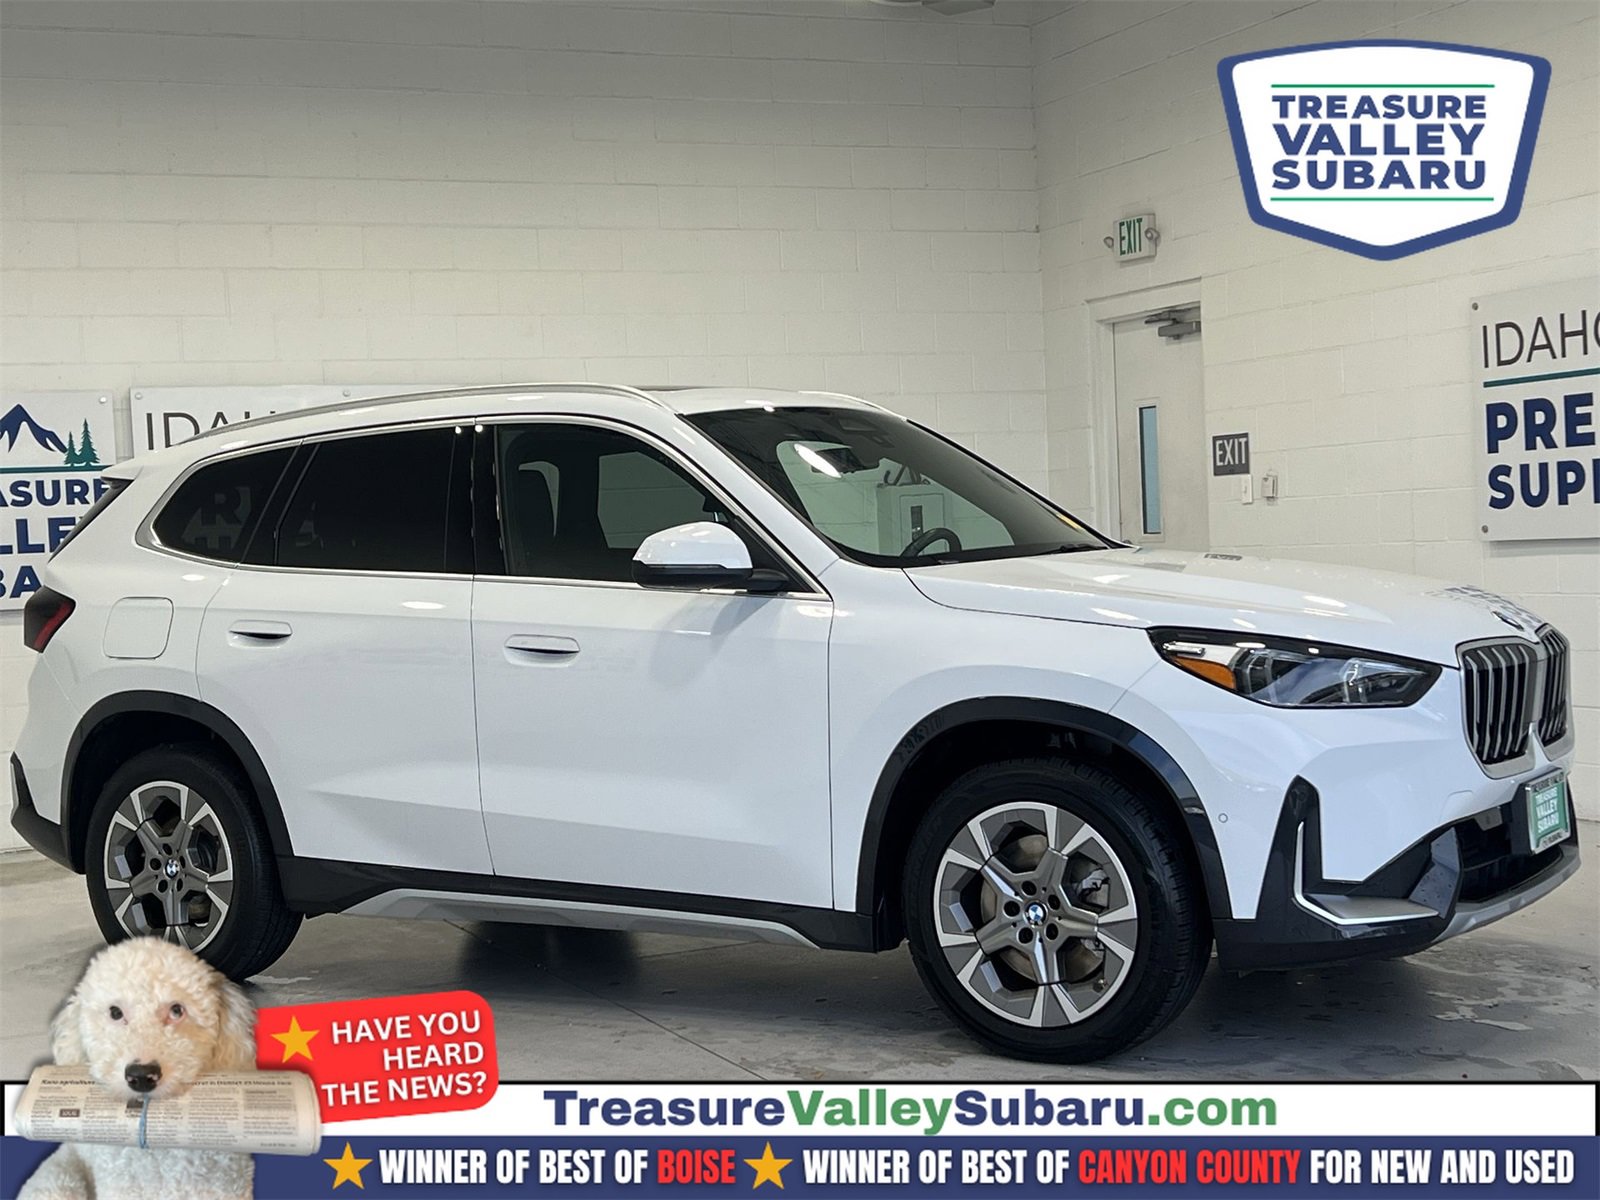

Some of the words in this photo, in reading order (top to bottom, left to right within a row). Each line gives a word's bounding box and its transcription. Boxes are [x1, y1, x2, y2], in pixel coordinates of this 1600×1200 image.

[1119, 217, 1143, 256] EXIT
[1482, 309, 1600, 369] IDAH
[1485, 392, 1596, 455] PRE
[1215, 437, 1248, 466] EXIT
[0, 478, 112, 508] SURE
